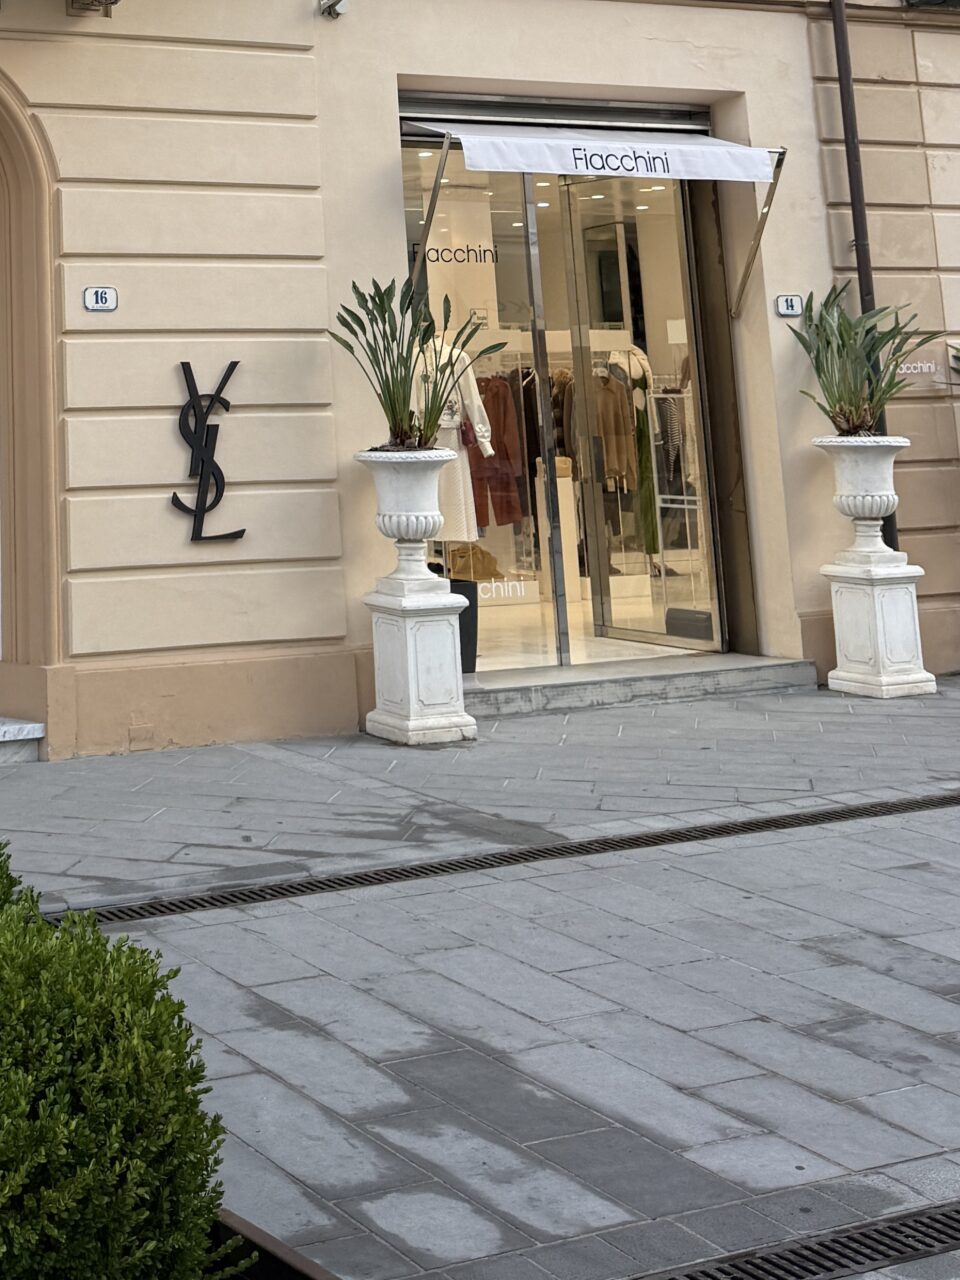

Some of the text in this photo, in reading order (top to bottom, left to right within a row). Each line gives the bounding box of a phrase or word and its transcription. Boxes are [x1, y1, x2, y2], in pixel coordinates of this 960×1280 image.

[572, 148, 670, 173] Fiacchini
[412, 243, 499, 263] Facchini
[93, 290, 108, 305] 16
[785, 297, 795, 311] 14
[897, 360, 936, 374] acchini
[479, 576, 525, 599] chini
